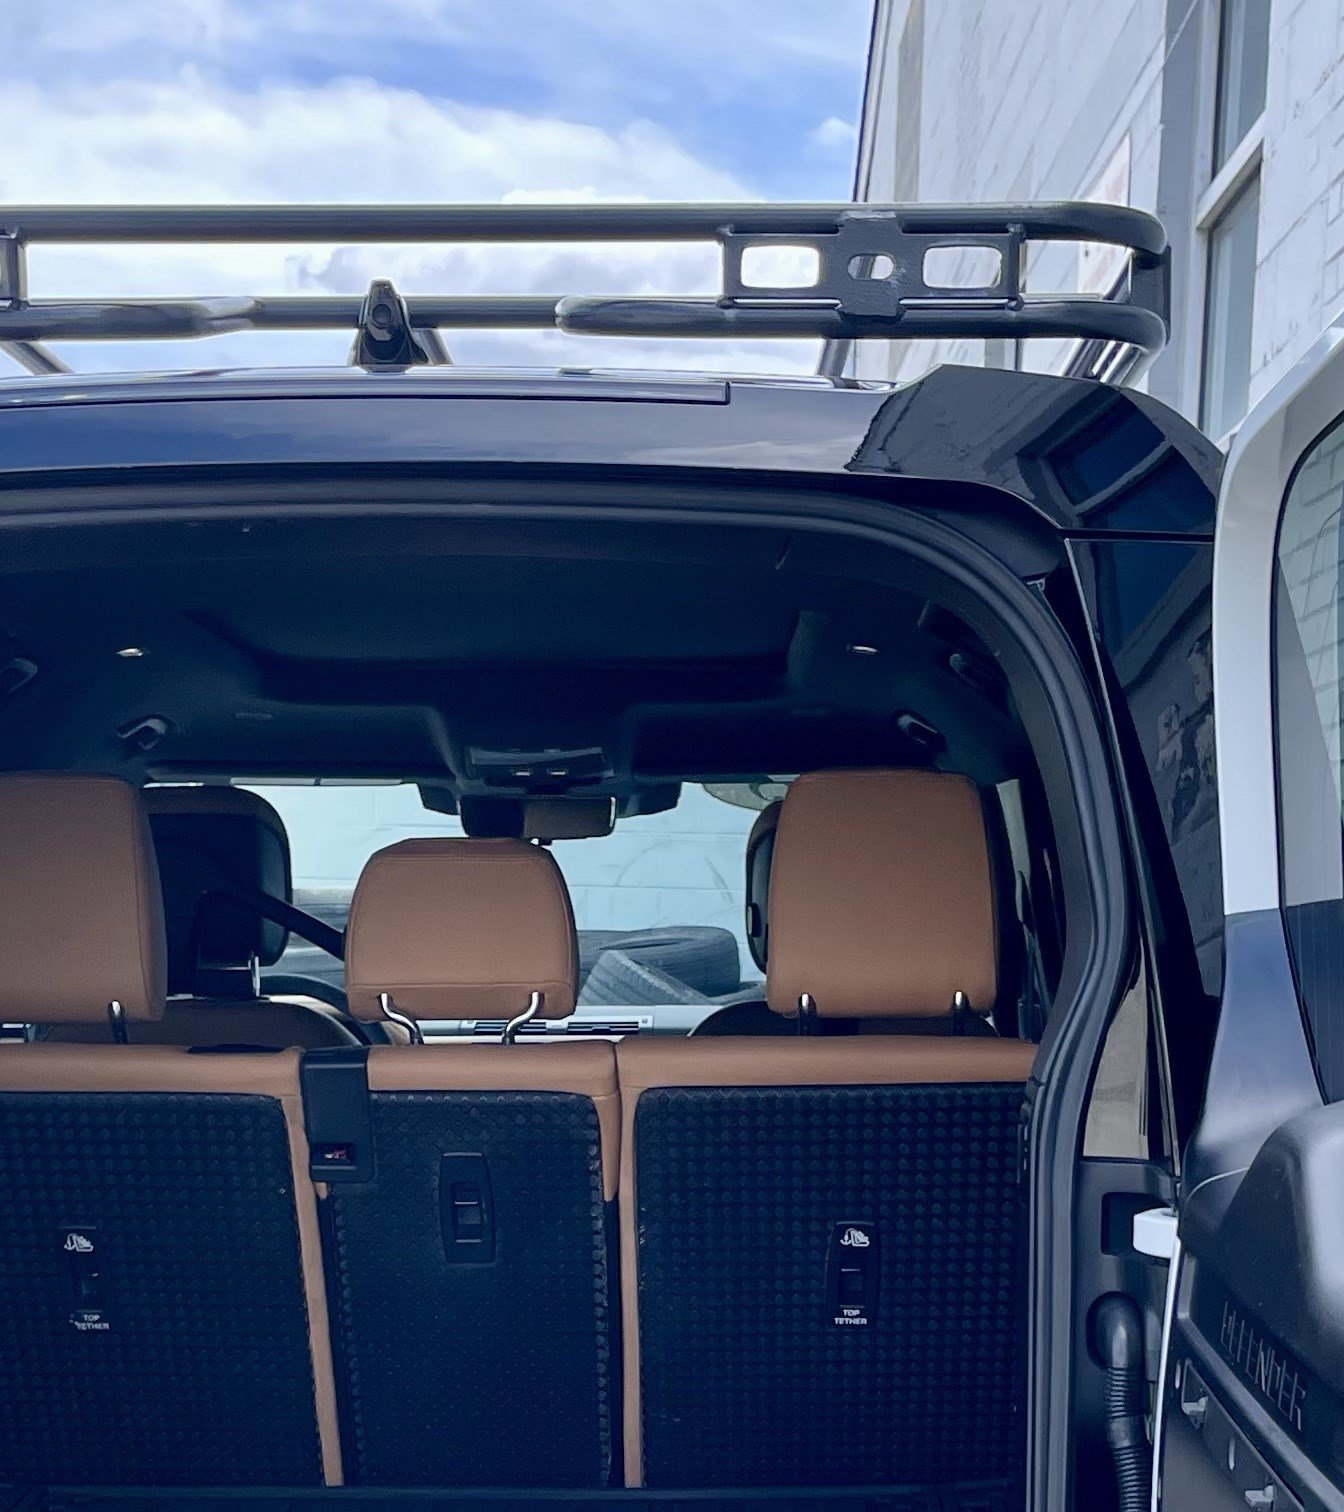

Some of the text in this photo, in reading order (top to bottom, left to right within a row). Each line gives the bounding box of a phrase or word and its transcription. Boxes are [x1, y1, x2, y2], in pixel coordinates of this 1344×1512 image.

[842, 1308, 861, 1317] TOP
[83, 1313, 101, 1321] TOP
[834, 1317, 868, 1325] TETHER
[1220, 1301, 1307, 1431] DEFENDER
